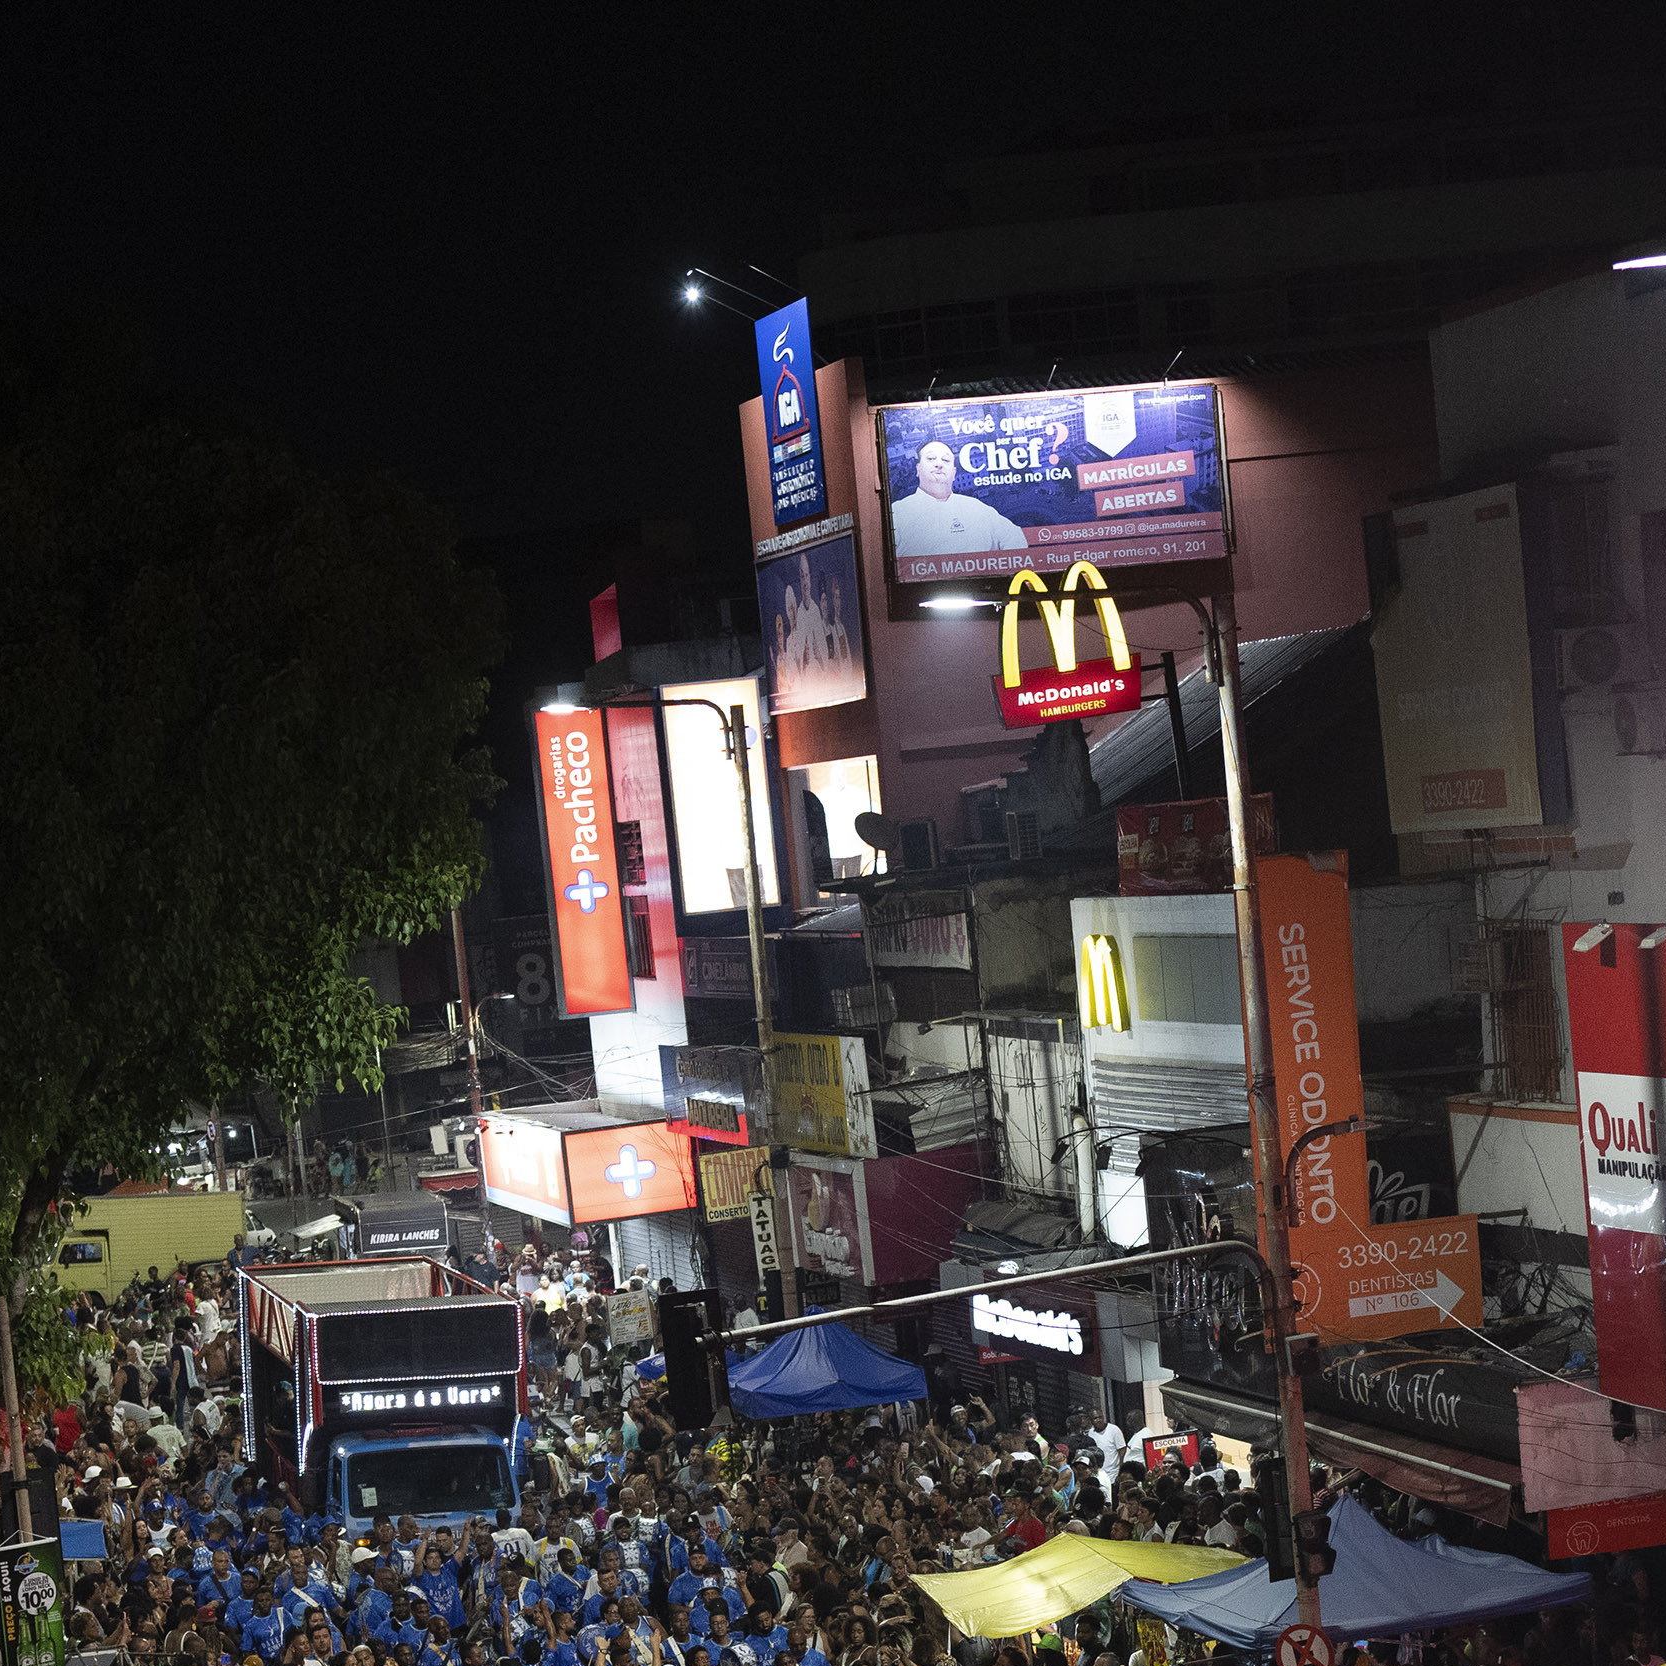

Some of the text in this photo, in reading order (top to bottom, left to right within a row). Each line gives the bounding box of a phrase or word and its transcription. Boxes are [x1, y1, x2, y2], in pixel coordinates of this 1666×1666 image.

[778, 389, 801, 428] IGA
[949, 413, 1046, 437] Você quer
[973, 467, 1072, 488] estude no IGA
[1083, 458, 1189, 485] MATRÍCULAS
[1101, 489, 1177, 512] ABERTAS
[1063, 525, 1123, 542] 99583-9799
[1137, 517, 1207, 534] @iga.madureira
[911, 561, 938, 576] IGA
[941, 555, 1034, 576] MADUREIRA
[1046, 551, 1071, 566] Rua
[1074, 547, 1110, 565] Edgar
[1163, 541, 1181, 556] 91,
[1185, 539, 1207, 554] 201
[1018, 679, 1125, 706] McDonald's
[1040, 700, 1106, 718] HAMBURGERS
[549, 736, 566, 799] drogarias
[564, 731, 600, 863] pacheco
[1278, 923, 1320, 1064] SERVICE
[370, 1228, 440, 1245] KIRIRA LANCHES
[753, 1196, 779, 1280] TATUAG
[1338, 1231, 1470, 1270] 3390-2422
[1348, 1270, 1436, 1296] DENTISTAS
[1390, 1293, 1420, 1309] 106
[1386, 1367, 1407, 1415] &
[1407, 1368, 1462, 1430] Flor
[1154, 1435, 1189, 1449] ESCOLHA
[1606, 1516, 1651, 1529] DENTISTAS
[4, 1604, 16, 1641] PREÇO
